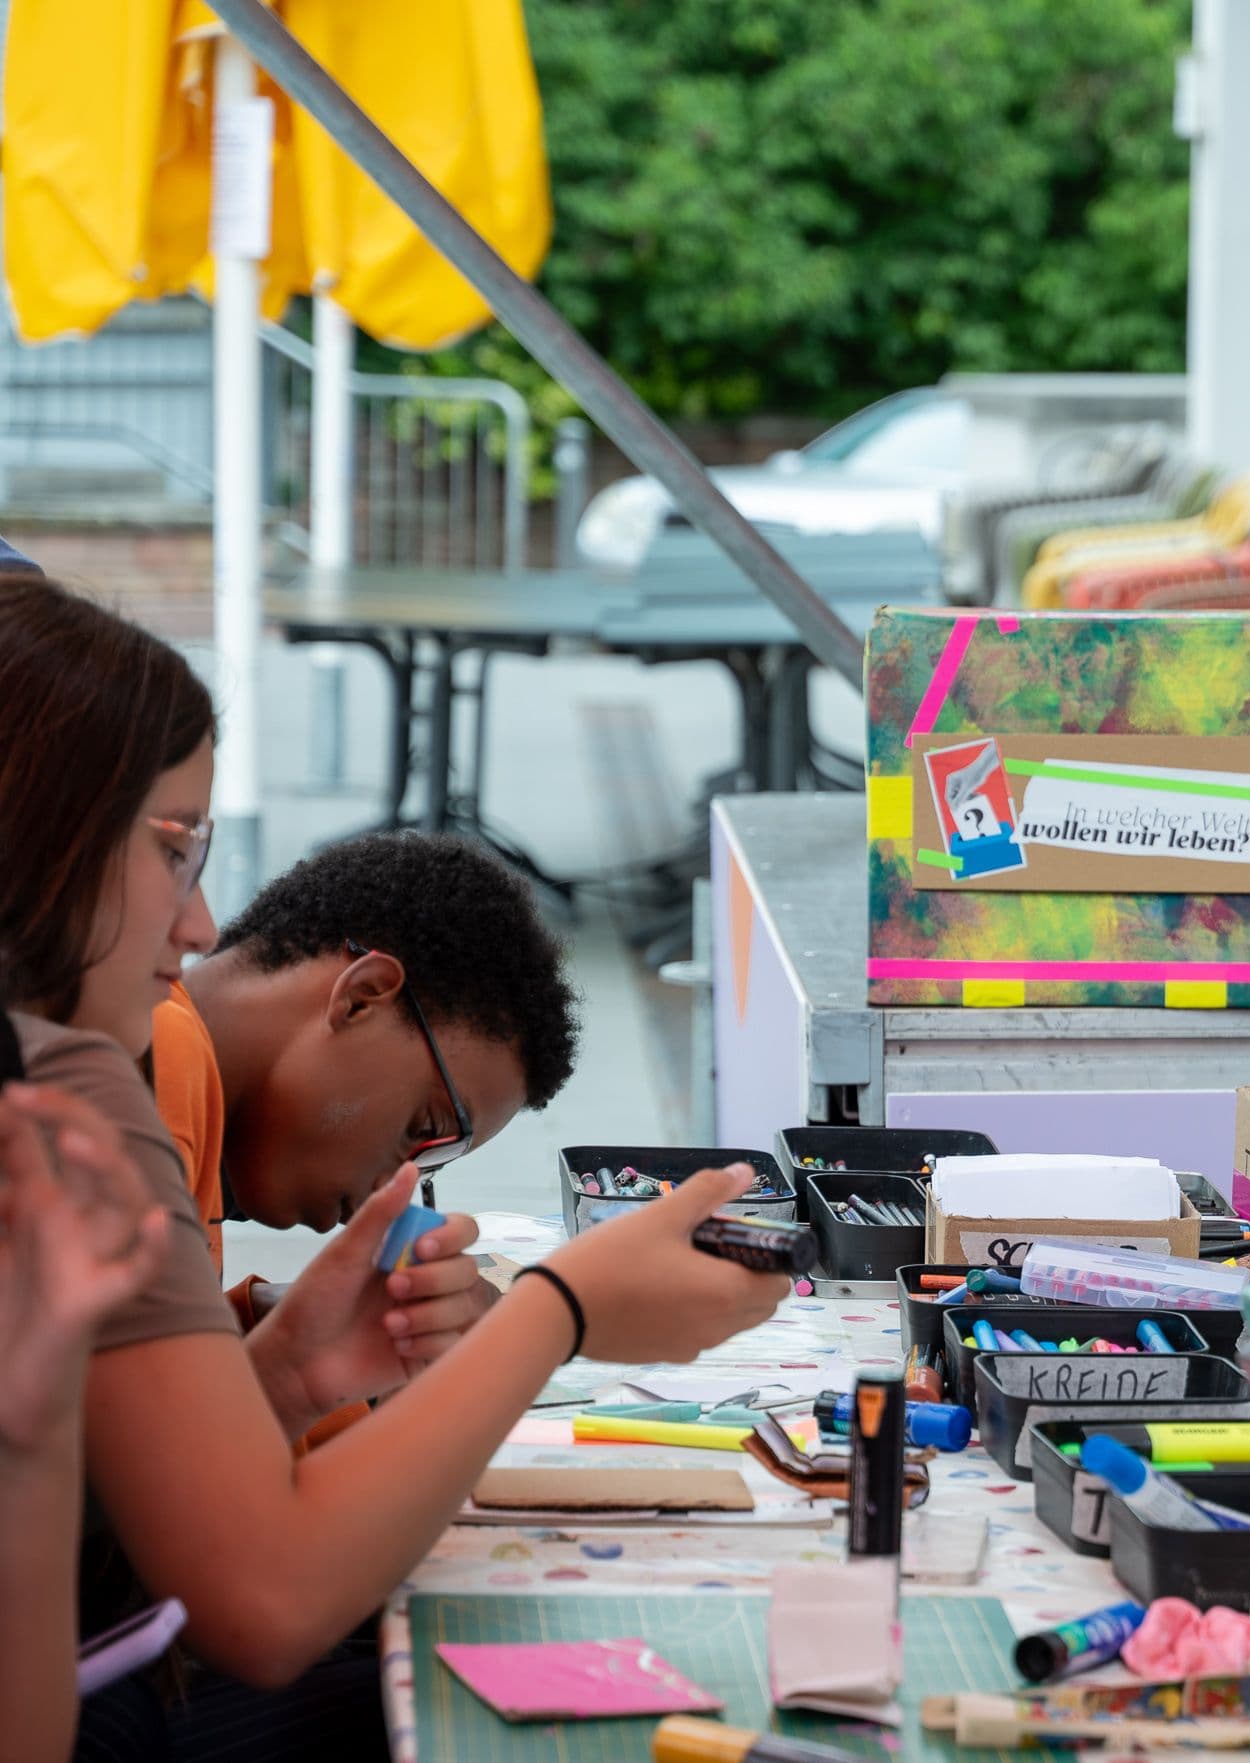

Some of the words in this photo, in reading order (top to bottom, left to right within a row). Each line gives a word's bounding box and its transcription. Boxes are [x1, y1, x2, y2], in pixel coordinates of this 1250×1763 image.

[1064, 801, 1087, 822] In
[1097, 805, 1191, 831] welcher
[1022, 820, 1108, 843] wollen
[1116, 826, 1161, 847] wir
[1168, 828, 1250, 853] leben?
